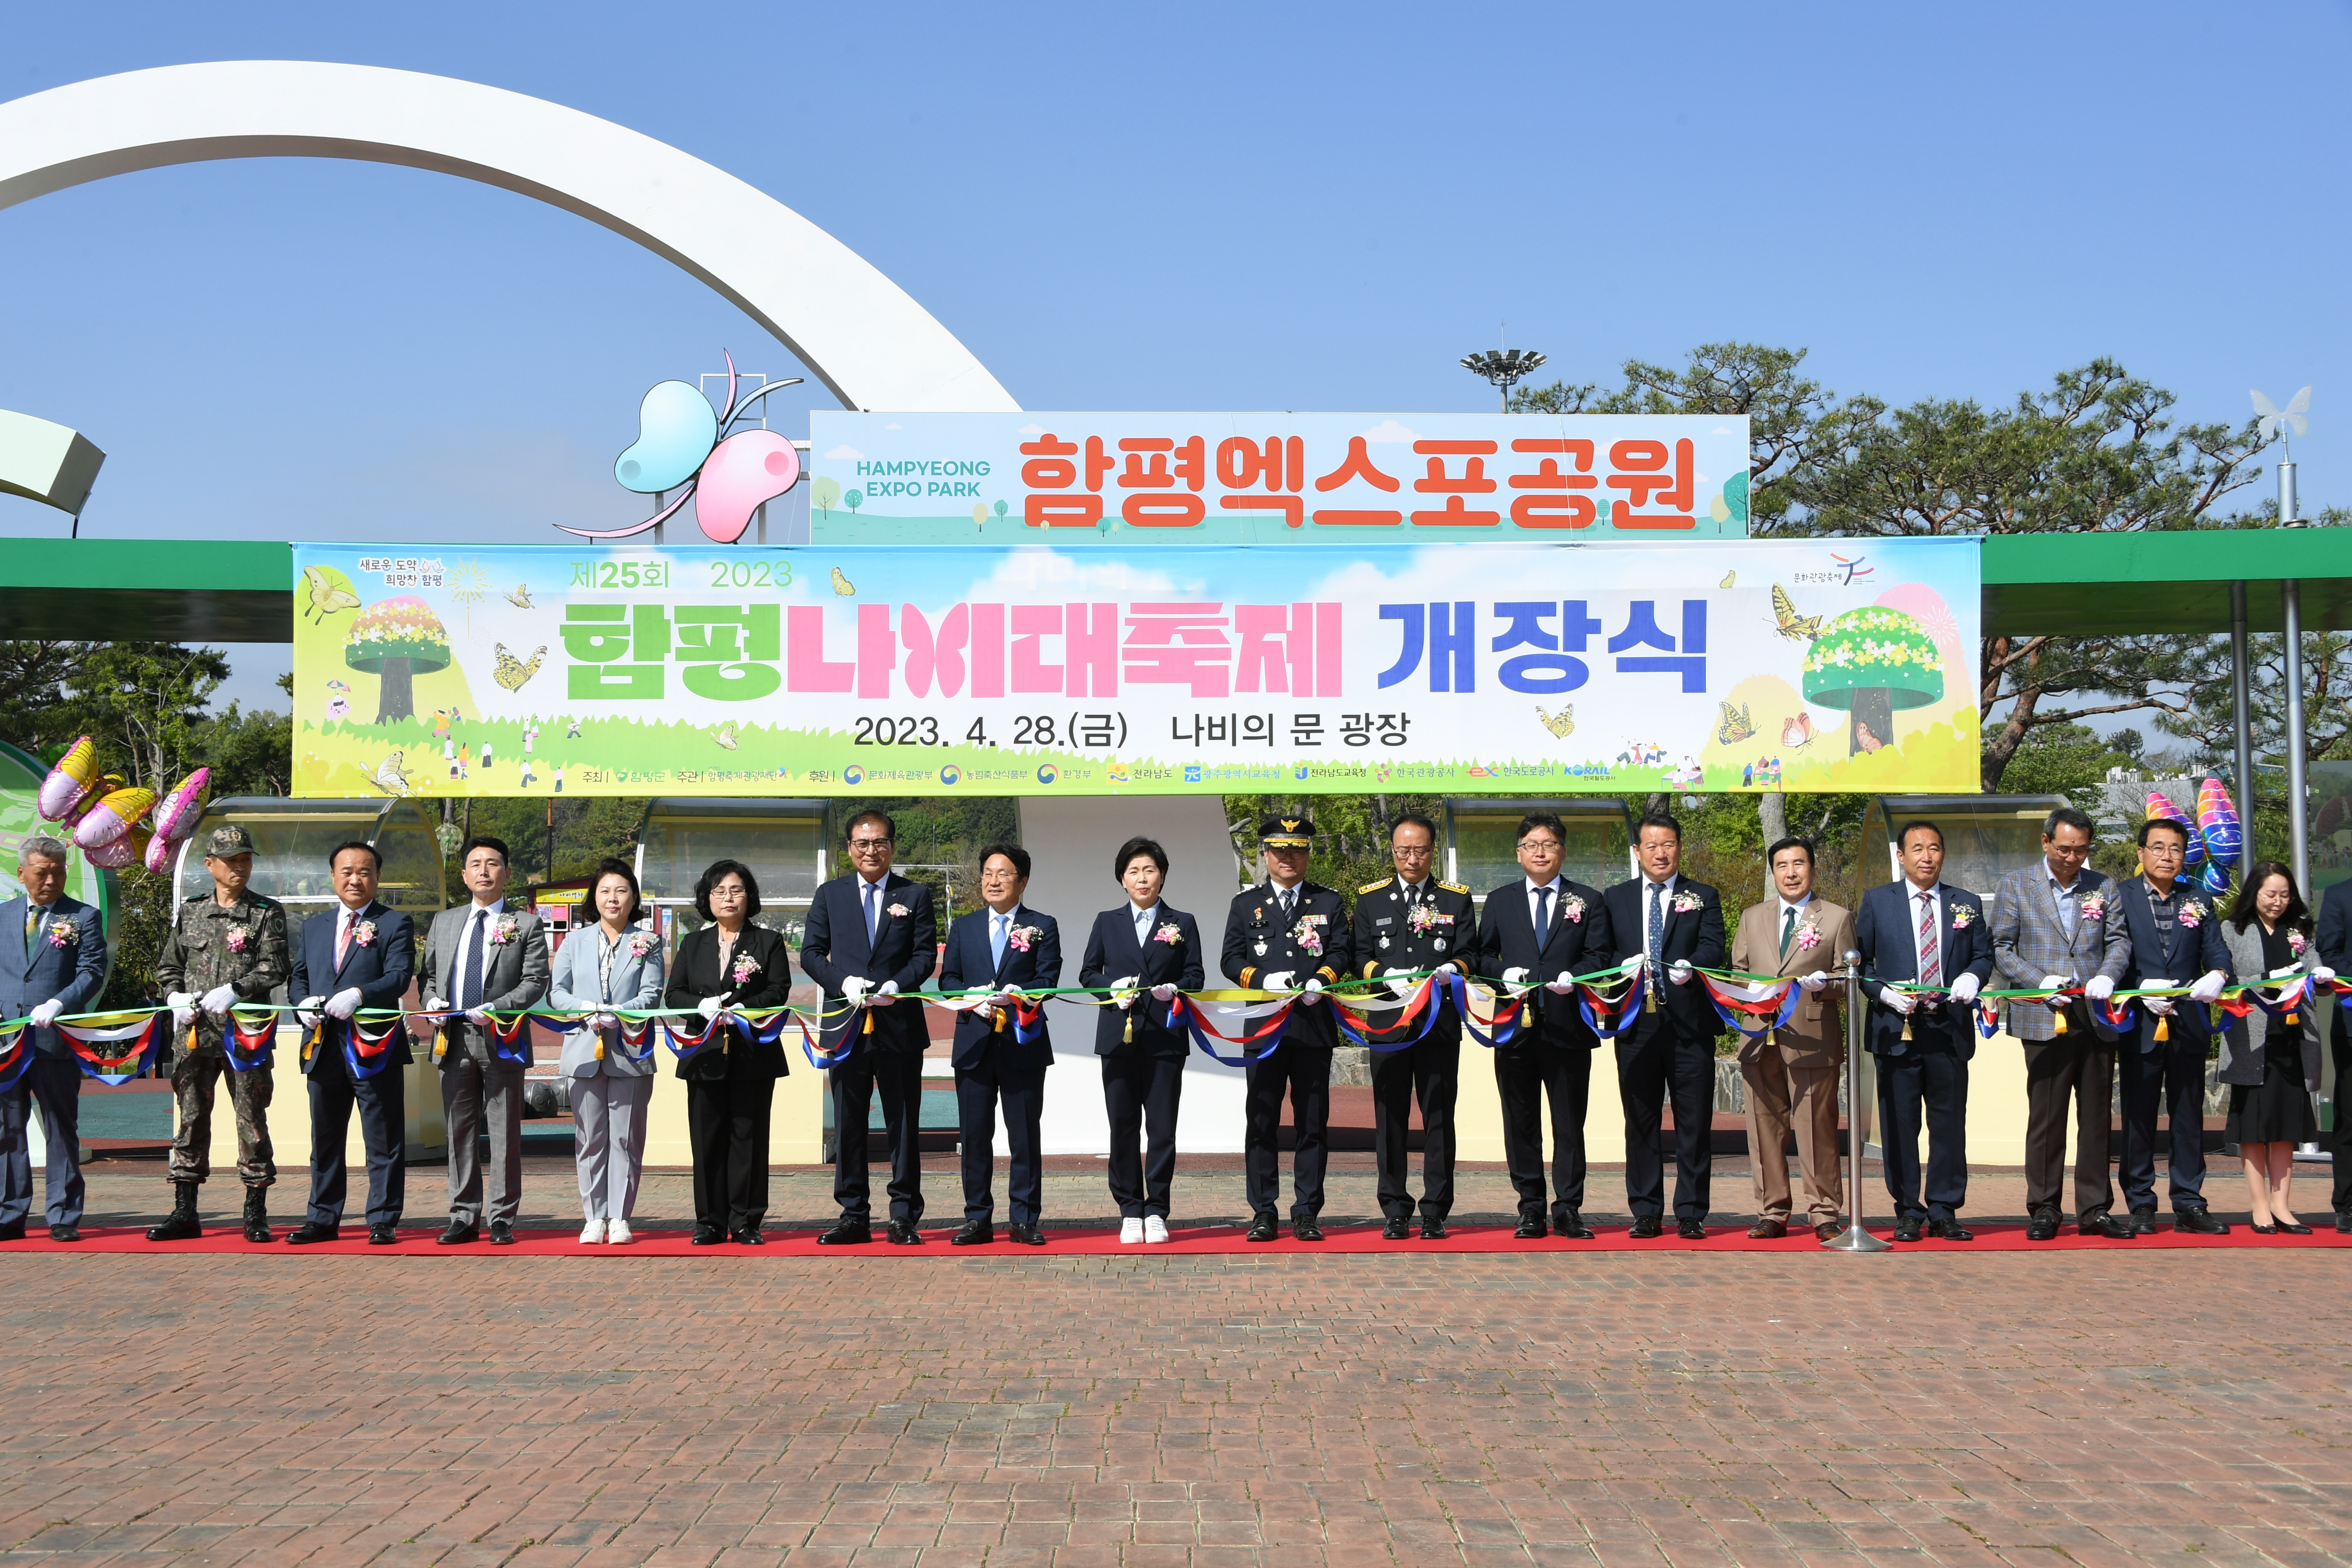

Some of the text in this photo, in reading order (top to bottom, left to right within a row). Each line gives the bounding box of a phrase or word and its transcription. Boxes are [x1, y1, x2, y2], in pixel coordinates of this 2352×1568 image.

[857, 461, 991, 476] HAMPYEONG
[1020, 433, 1696, 529] 함평엑스포공원
[867, 482, 981, 497] EXPO PARK
[360, 559, 417, 571] 새로운 도약
[570, 560, 792, 588] 제25회 2023
[1794, 572, 1842, 583] 문화관광축제
[386, 574, 442, 586] 희망찬 함평
[1378, 600, 1707, 694] 개장식
[854, 712, 1410, 749] 2023. 4. 28.(금) 나비의 문 광장
[631, 772, 665, 782] 함평군
[708, 770, 778, 782] 함평축제관광재단
[869, 770, 932, 780] 문화체육관광부
[966, 770, 1027, 780] 농림축산식품부
[1063, 770, 1091, 779] 환경부
[1133, 769, 1173, 779] 전라남도
[1203, 769, 1280, 779] 광주광역시교육청
[1310, 768, 1366, 778] 전라남도교육청
[1396, 768, 1454, 778] 한국관광공사
[1503, 767, 1554, 776] 한국도로공사
